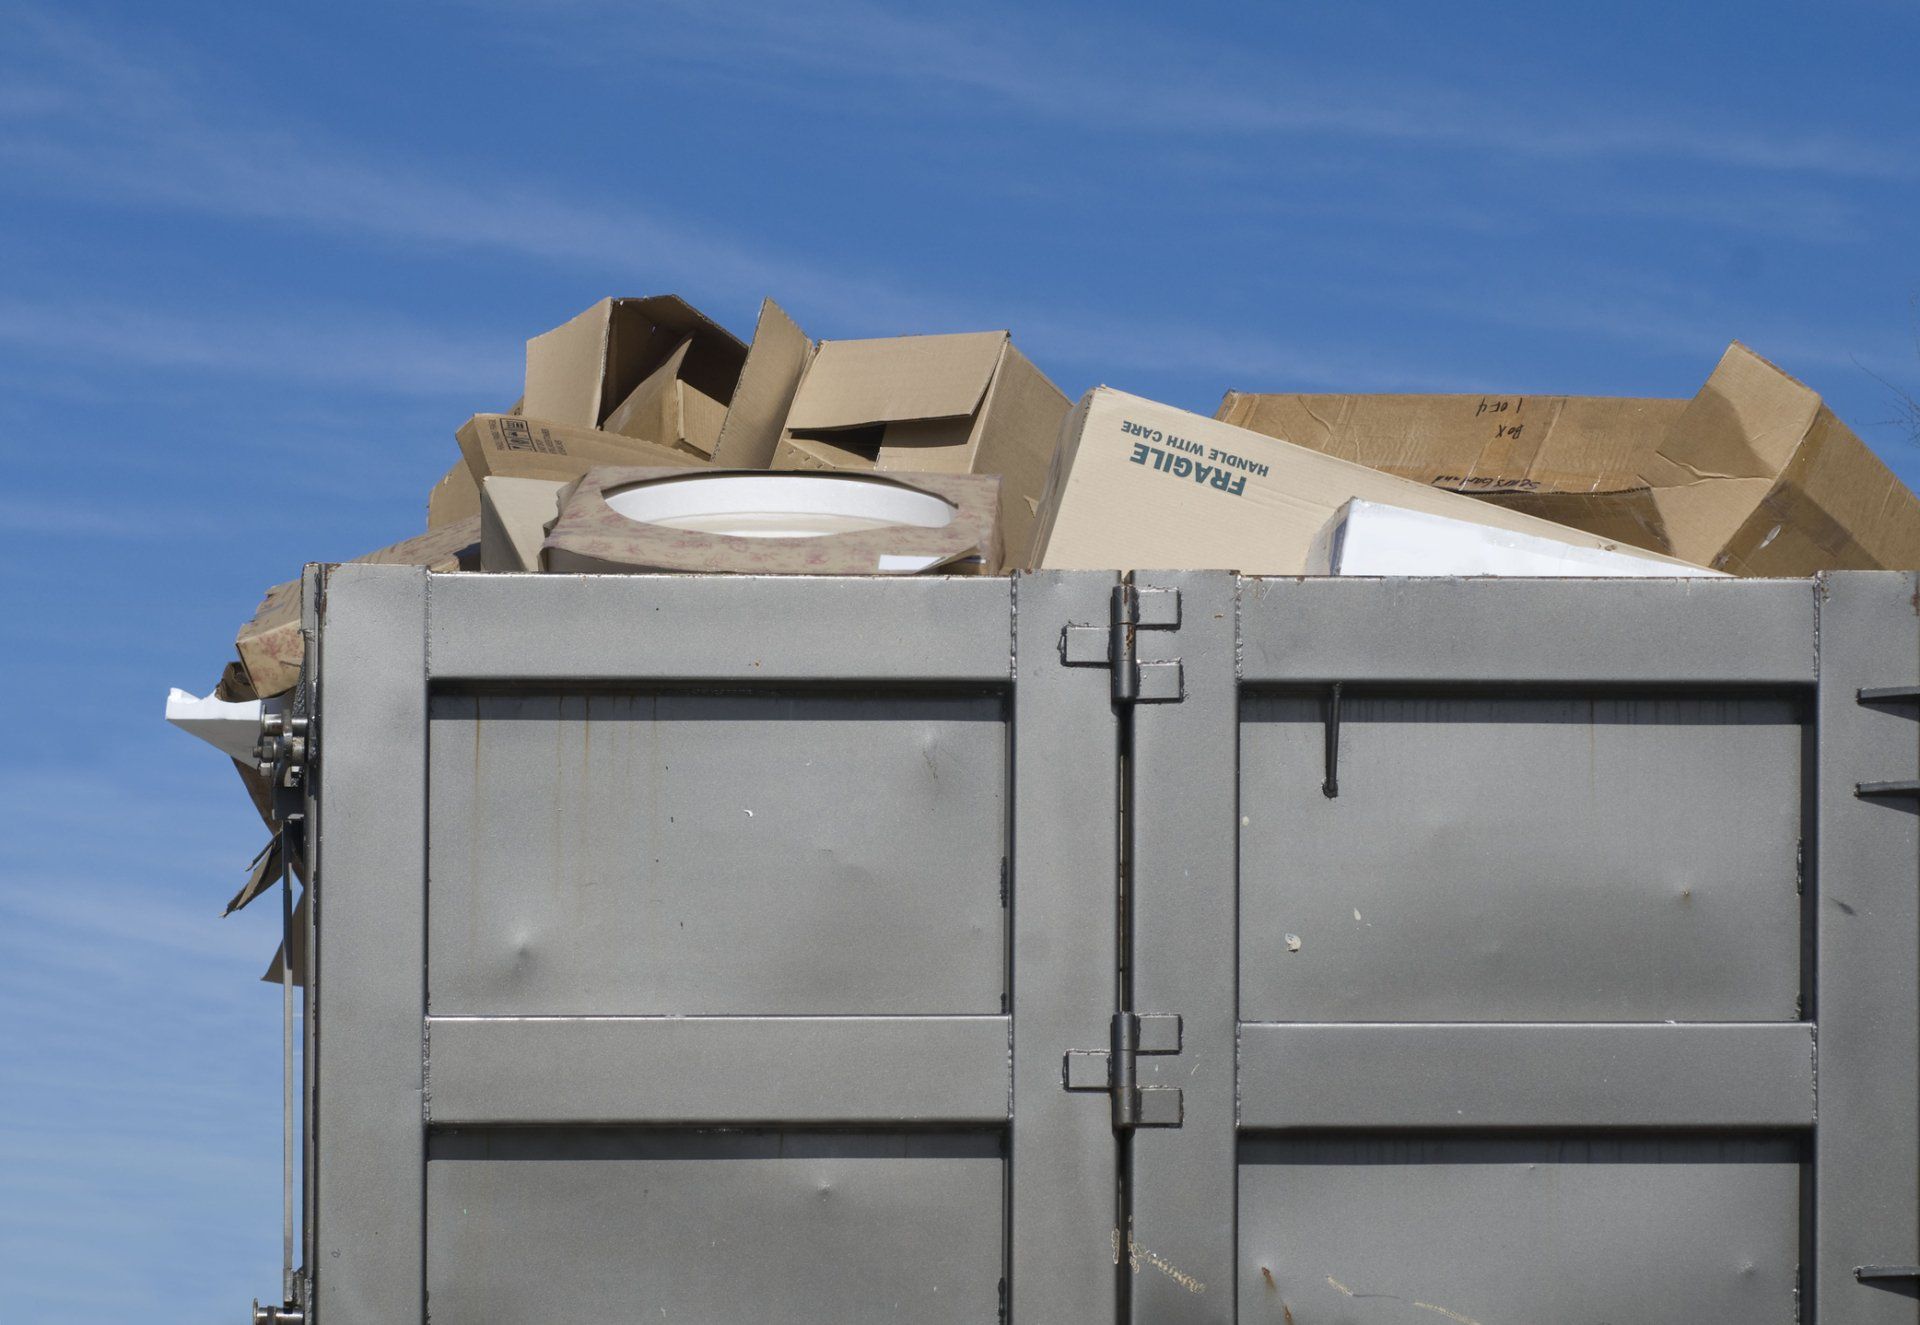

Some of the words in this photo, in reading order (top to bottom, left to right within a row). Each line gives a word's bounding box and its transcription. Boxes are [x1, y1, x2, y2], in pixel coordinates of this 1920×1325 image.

[1475, 397, 1488, 417] 4
[1121, 419, 1163, 443] CARE
[1166, 434, 1204, 457] WITH
[1130, 442, 1247, 496] FRAGILE
[1208, 448, 1270, 477] HANDLE
